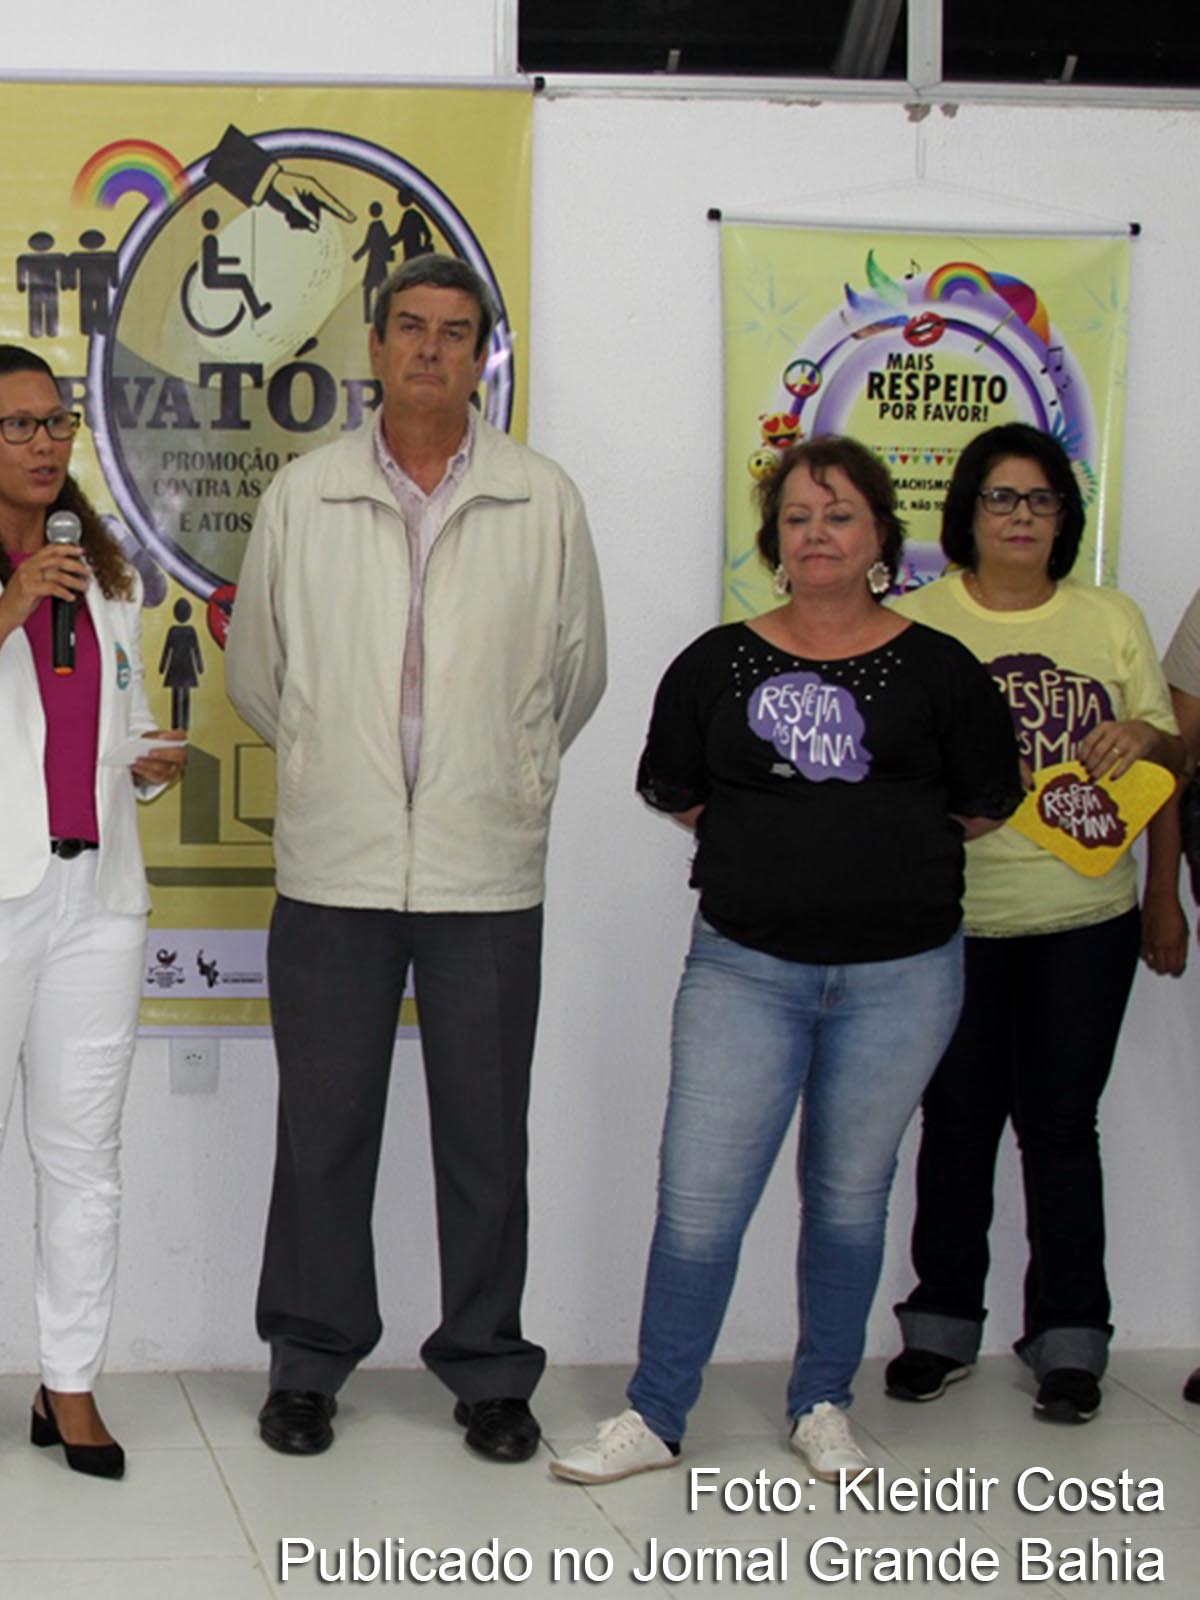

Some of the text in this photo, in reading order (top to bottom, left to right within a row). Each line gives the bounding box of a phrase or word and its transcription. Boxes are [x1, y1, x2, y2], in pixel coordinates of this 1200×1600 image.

[886, 353, 934, 371] MAIS
[867, 372, 1008, 405] RESPEITO
[879, 403, 989, 422] POR FAVOR!
[162, 448, 279, 476] PROMOÇÃO
[153, 479, 262, 497] CONTRA AS
[180, 513, 253, 532] E ATOS
[757, 683, 842, 728] RESPEITA
